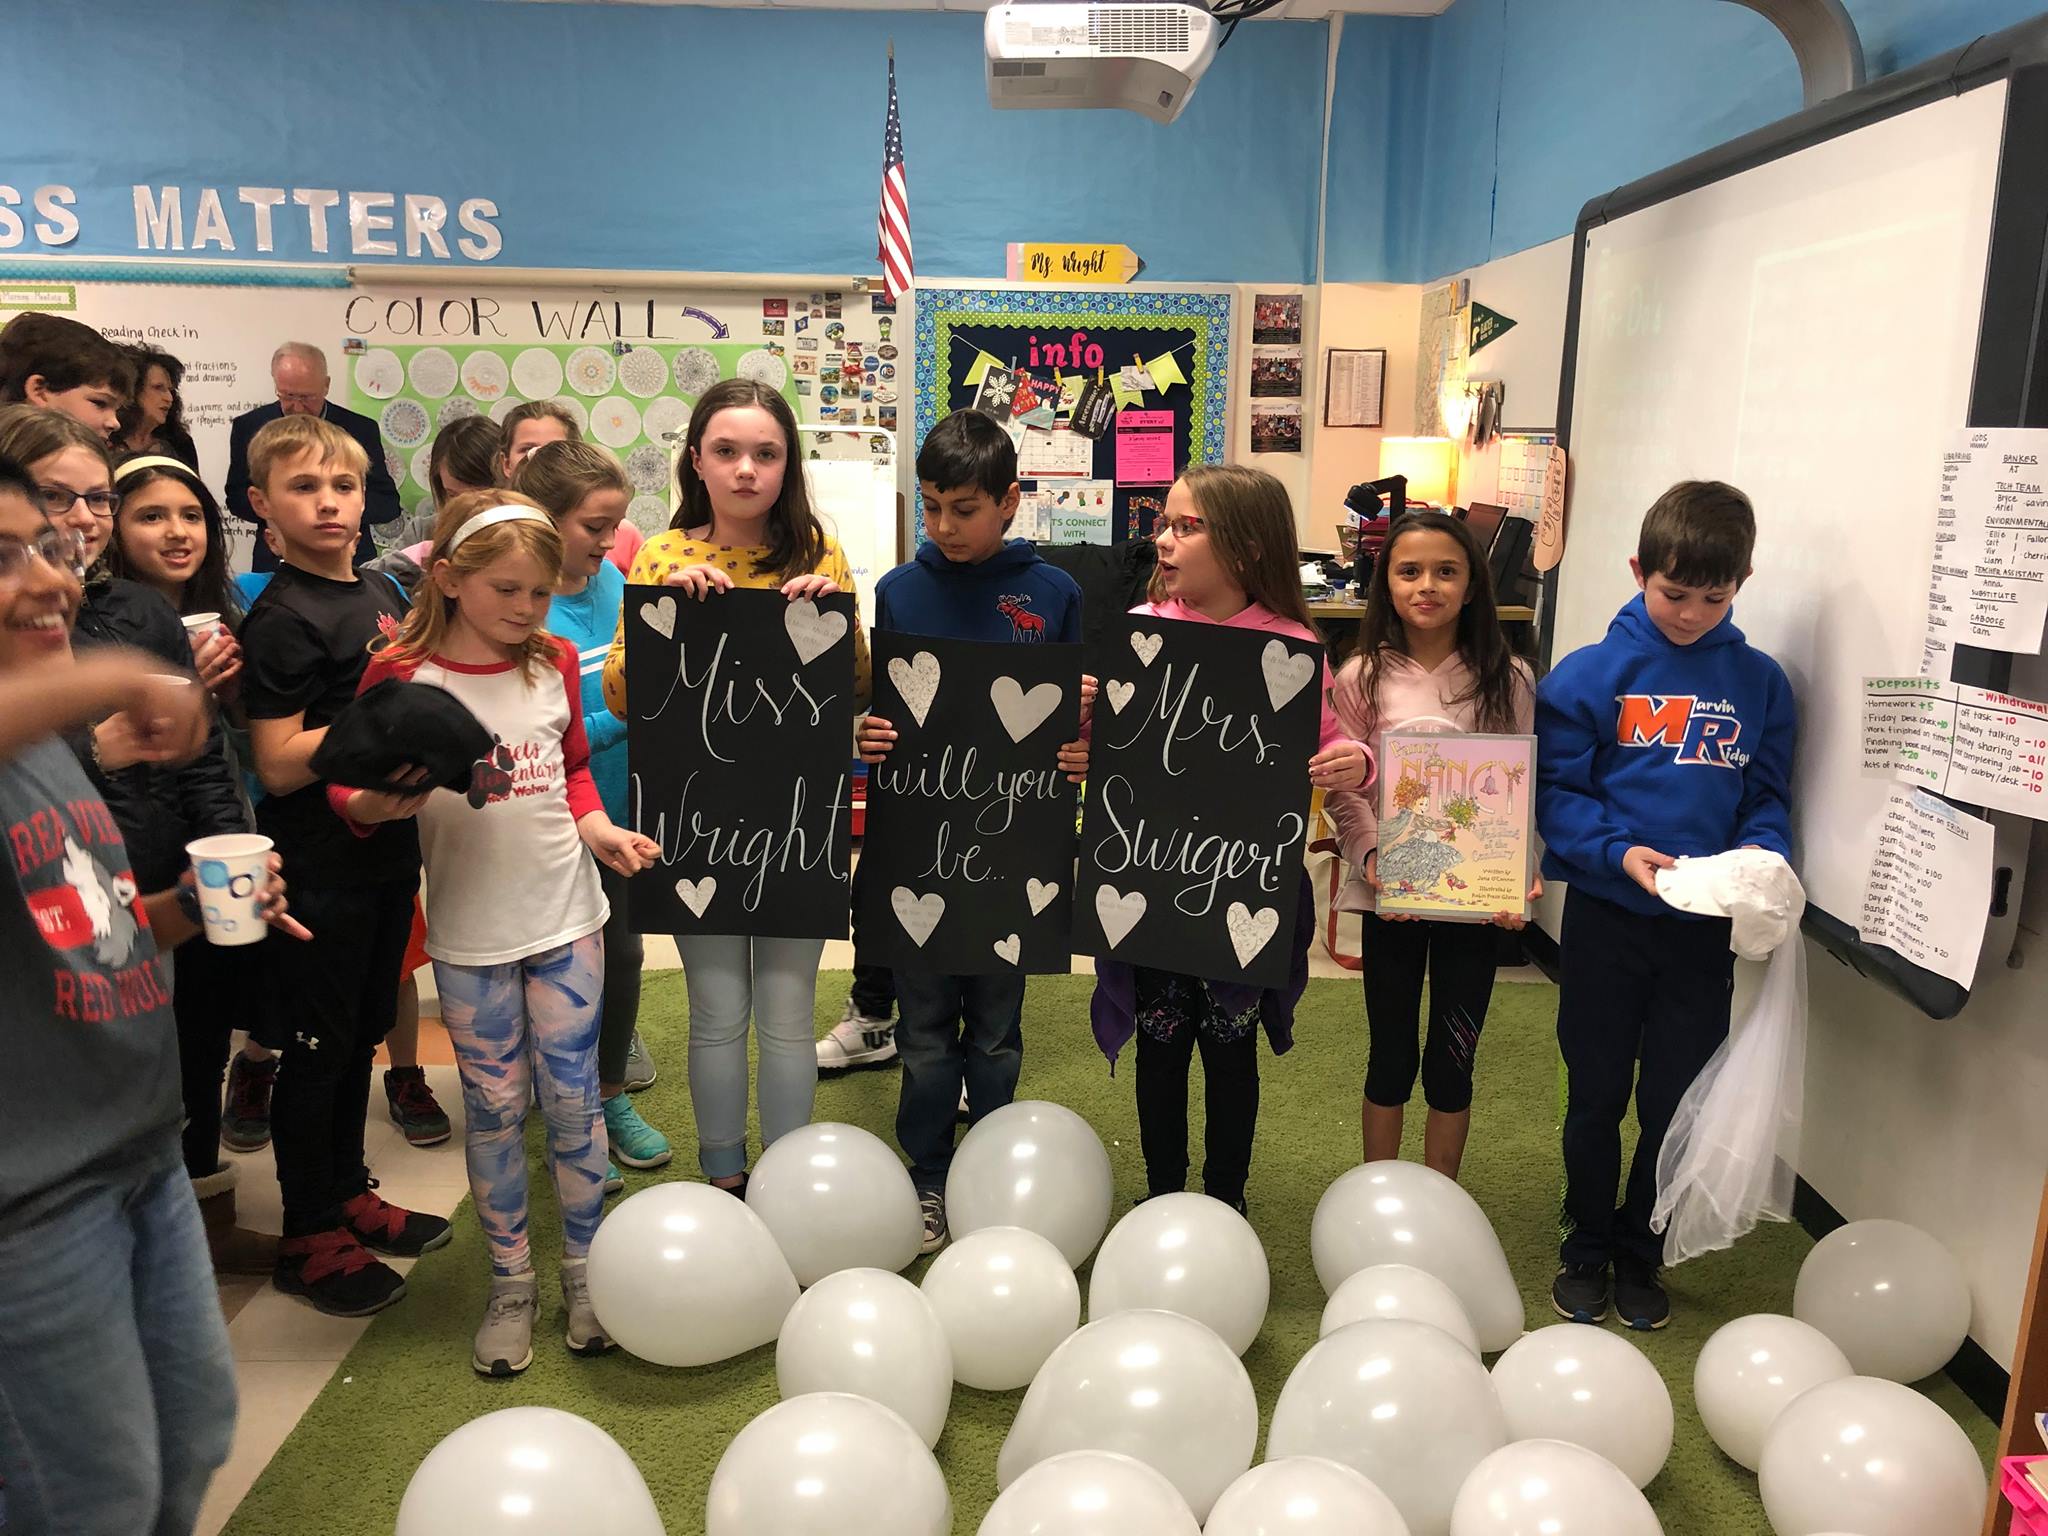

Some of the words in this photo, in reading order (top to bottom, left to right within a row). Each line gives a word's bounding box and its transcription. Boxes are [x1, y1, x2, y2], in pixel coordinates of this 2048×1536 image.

[133, 185, 502, 261] MATTERS
[345, 296, 507, 337] COLOR
[531, 299, 679, 341] WALL
[101, 326, 144, 342] Reading
[183, 325, 199, 340] in
[1029, 332, 1105, 369] info
[195, 361, 238, 371] fractions
[185, 374, 199, 383] and
[202, 374, 236, 388] drawings
[1031, 379, 1062, 394] HAPPY
[227, 401, 241, 411] and
[2003, 454, 2038, 464] BANKER
[1996, 481, 2013, 491] TECH
[2016, 482, 2041, 492] TEAM
[1065, 518, 1107, 527] CONNECT
[1063, 530, 1086, 538] WITH
[1975, 565, 2001, 576] TEACHER
[2002, 568, 2045, 579] ASSISTANT
[642, 633, 837, 763] Miss
[1868, 700, 1916, 708] Homework
[1919, 702, 1934, 711] +5
[1107, 663, 1281, 776] Mrs.
[1868, 713, 1897, 725] Friday
[1973, 709, 1993, 722] task
[1996, 716, 2017, 725] -10
[1988, 728, 2021, 748] talking
[2024, 739, 2047, 749] -10
[1900, 748, 1920, 760] +20
[1977, 741, 2014, 761] sharing
[1864, 760, 1880, 769] Acts
[1883, 760, 1891, 769] of
[2022, 767, 2045, 781] -10
[877, 745, 995, 801] will
[975, 769, 1061, 836] you
[2022, 781, 2043, 793] -10
[1094, 775, 1304, 917] Swiger?
[1871, 869, 1882, 878] No
[1925, 867, 1943, 880] $100
[54, 967, 116, 1024] RED
